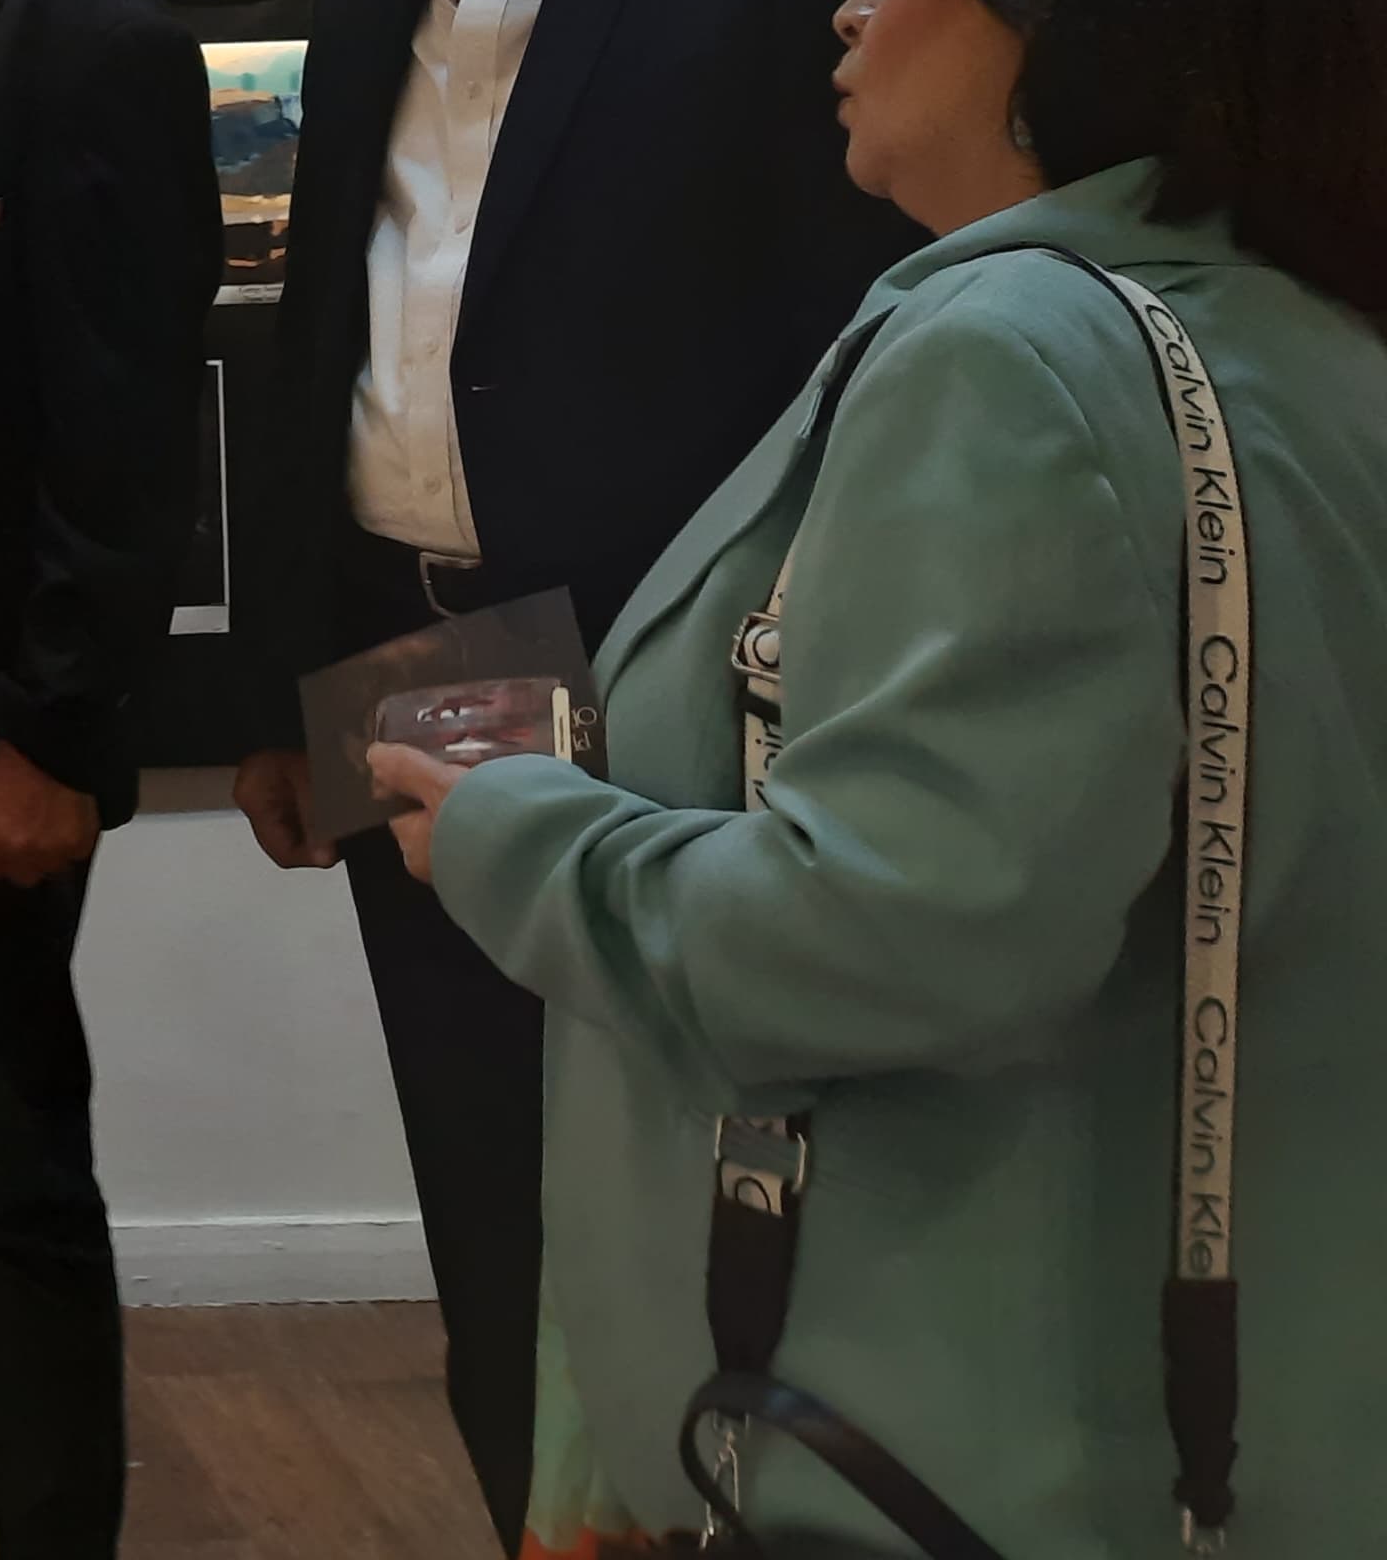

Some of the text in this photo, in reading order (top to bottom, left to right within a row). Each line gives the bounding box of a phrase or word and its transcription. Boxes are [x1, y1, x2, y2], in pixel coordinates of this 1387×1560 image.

[1144, 304, 1235, 586] Calvin Klein
[1194, 634, 1239, 946] Calvin Klein
[1190, 996, 1227, 1175] Calvin
